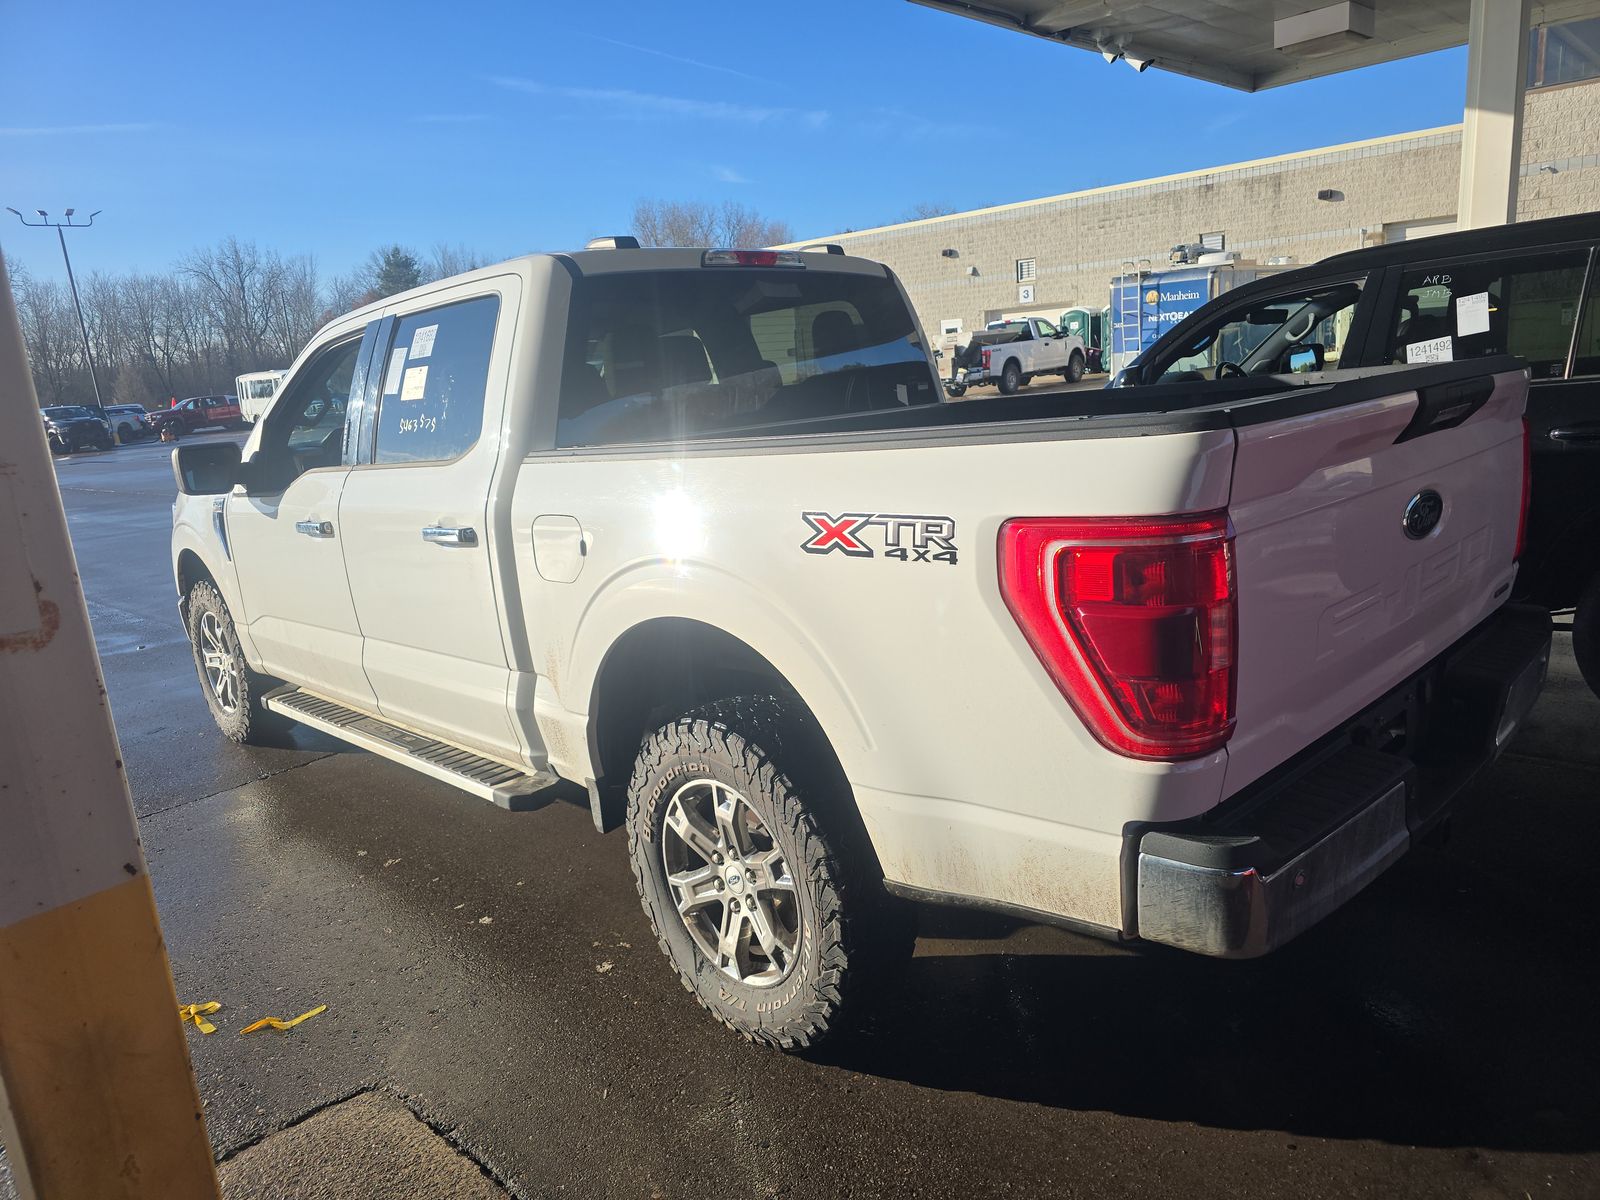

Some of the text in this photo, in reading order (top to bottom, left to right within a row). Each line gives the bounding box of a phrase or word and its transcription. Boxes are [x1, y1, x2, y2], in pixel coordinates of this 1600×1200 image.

[1023, 289, 1030, 299] 3
[1160, 290, 1200, 302] Manheim
[1148, 310, 1193, 322] NEXTGEA
[1409, 339, 1452, 358] 1241492
[800, 511, 958, 558] XTR
